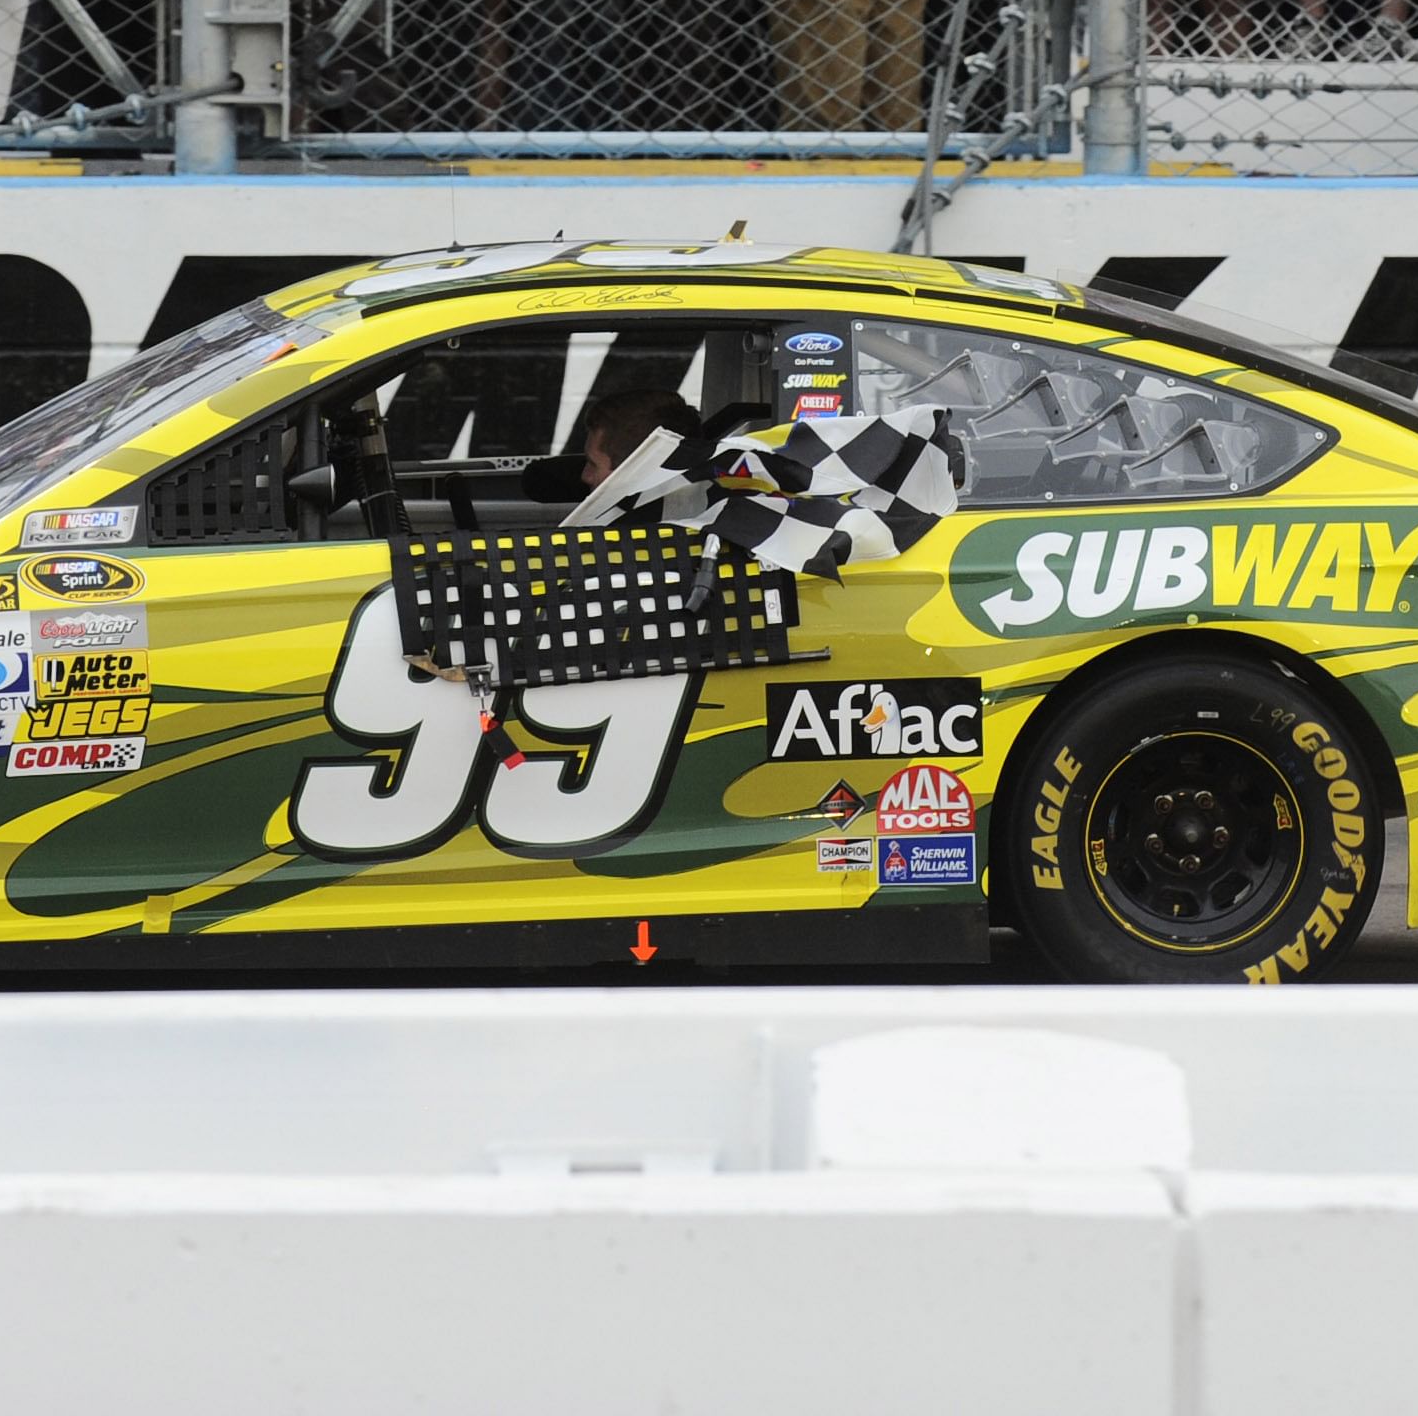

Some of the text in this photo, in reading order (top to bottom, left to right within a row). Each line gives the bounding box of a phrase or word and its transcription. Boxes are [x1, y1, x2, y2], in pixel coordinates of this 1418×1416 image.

[796, 335, 832, 351] Ford
[782, 373, 848, 389] SUBWAY
[65, 511, 118, 528] NASCAR
[29, 530, 124, 542] RACE CAR
[55, 561, 99, 574] NASCAR
[61, 573, 103, 589] Sprint
[39, 619, 138, 639] Coors LIGHT
[52, 635, 125, 649] POLE
[70, 654, 133, 674] Auto
[66, 672, 147, 695] Meter
[30, 697, 151, 739] JEGS
[293, 582, 693, 850] 99
[14, 743, 112, 769] COMP
[80, 759, 127, 770] CAMS
[880, 767, 970, 812] MAC
[880, 812, 971, 830] TOOLS
[1031, 745, 1083, 891] EAGLE
[821, 846, 869, 857] CHAMPION
[911, 846, 967, 860] SHERWIN
